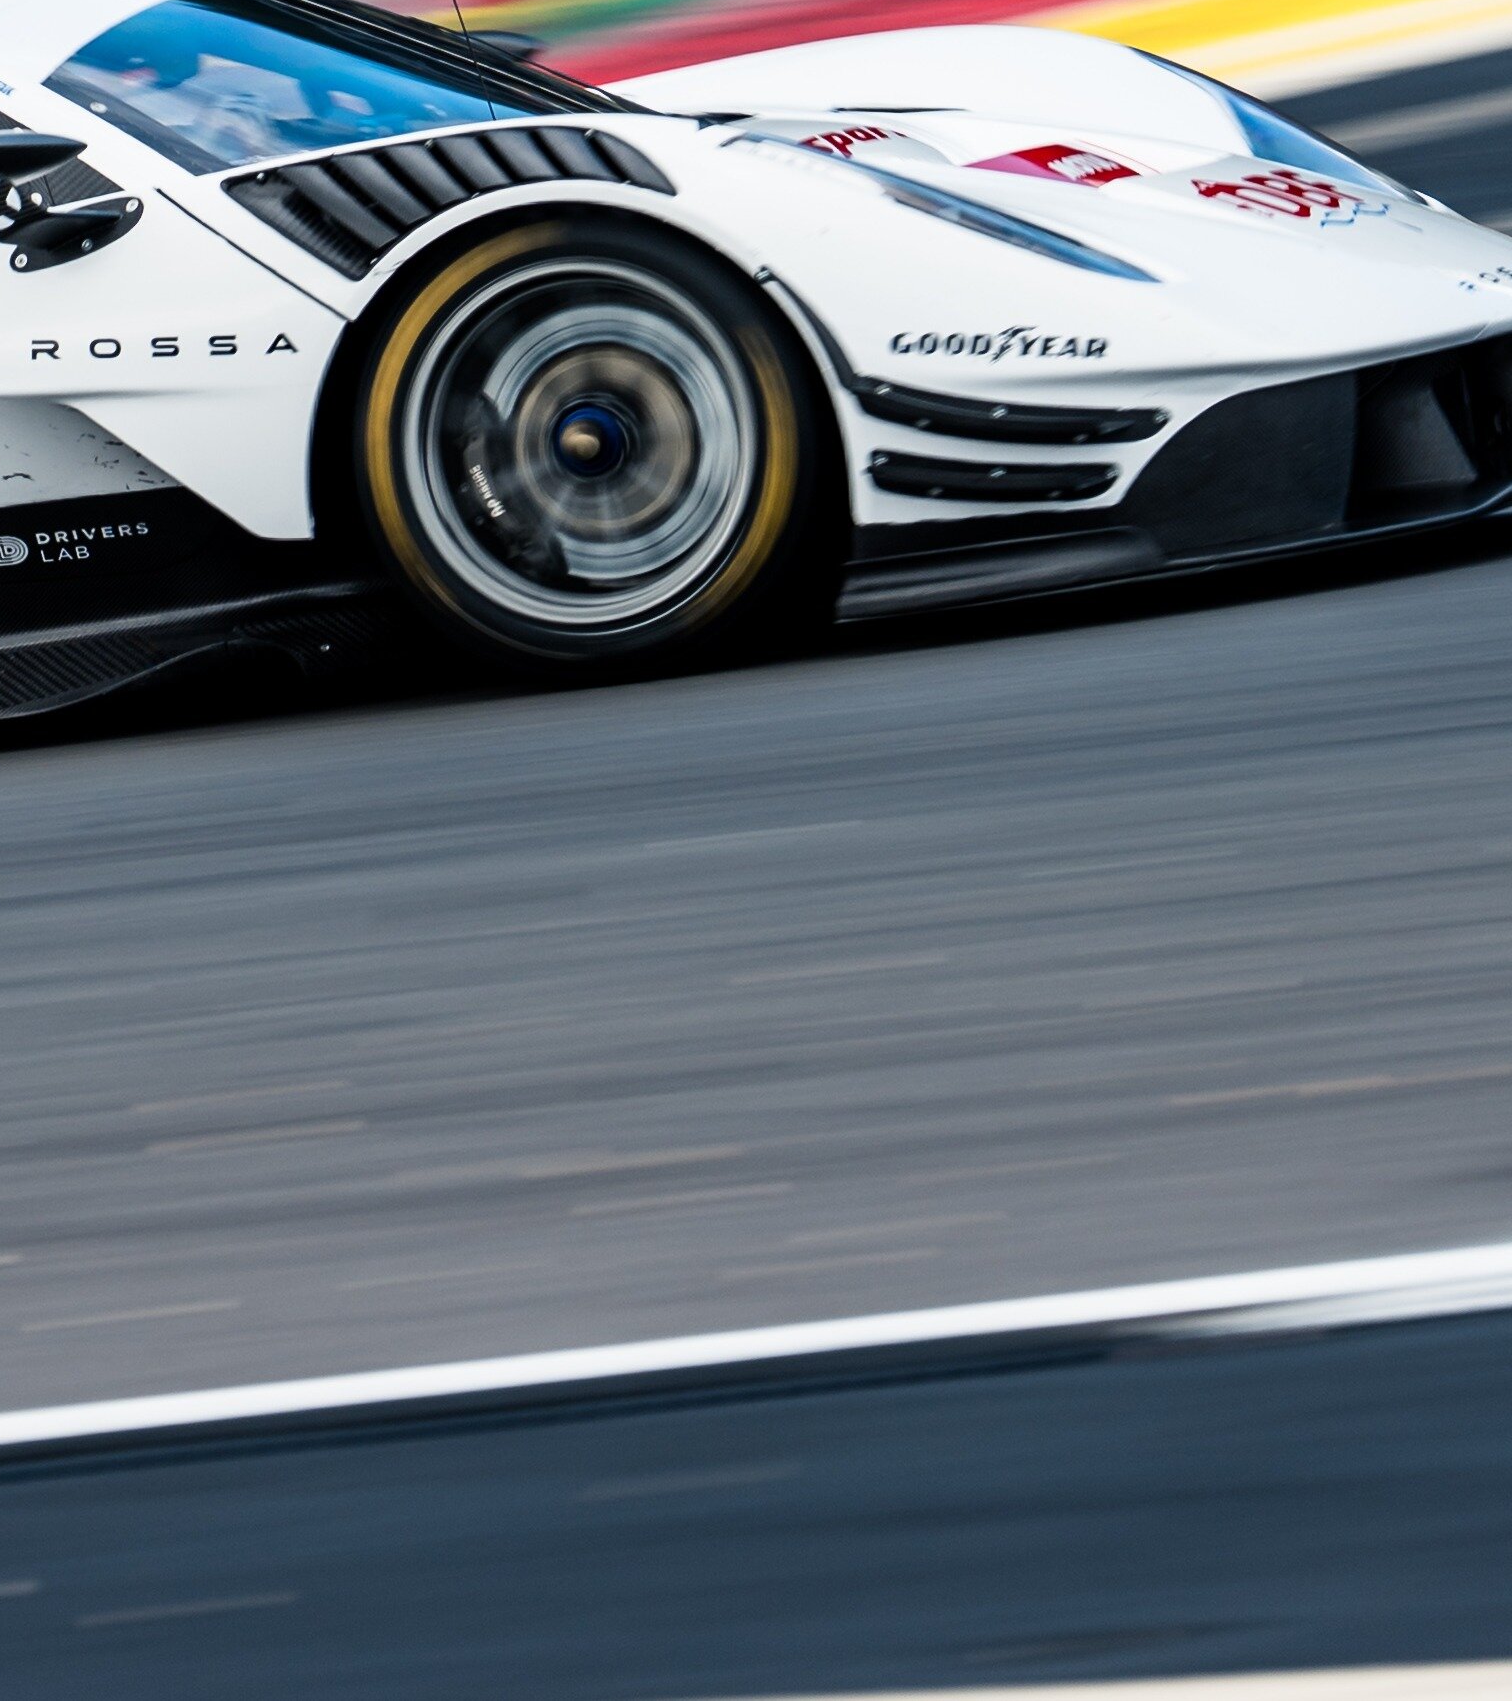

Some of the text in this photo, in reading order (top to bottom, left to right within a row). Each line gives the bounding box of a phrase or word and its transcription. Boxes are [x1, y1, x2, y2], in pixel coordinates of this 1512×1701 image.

[798, 126, 907, 159] spar
[30, 332, 300, 360] ROSSA
[35, 522, 149, 545] DRIVERS
[41, 546, 90, 563] LAB
